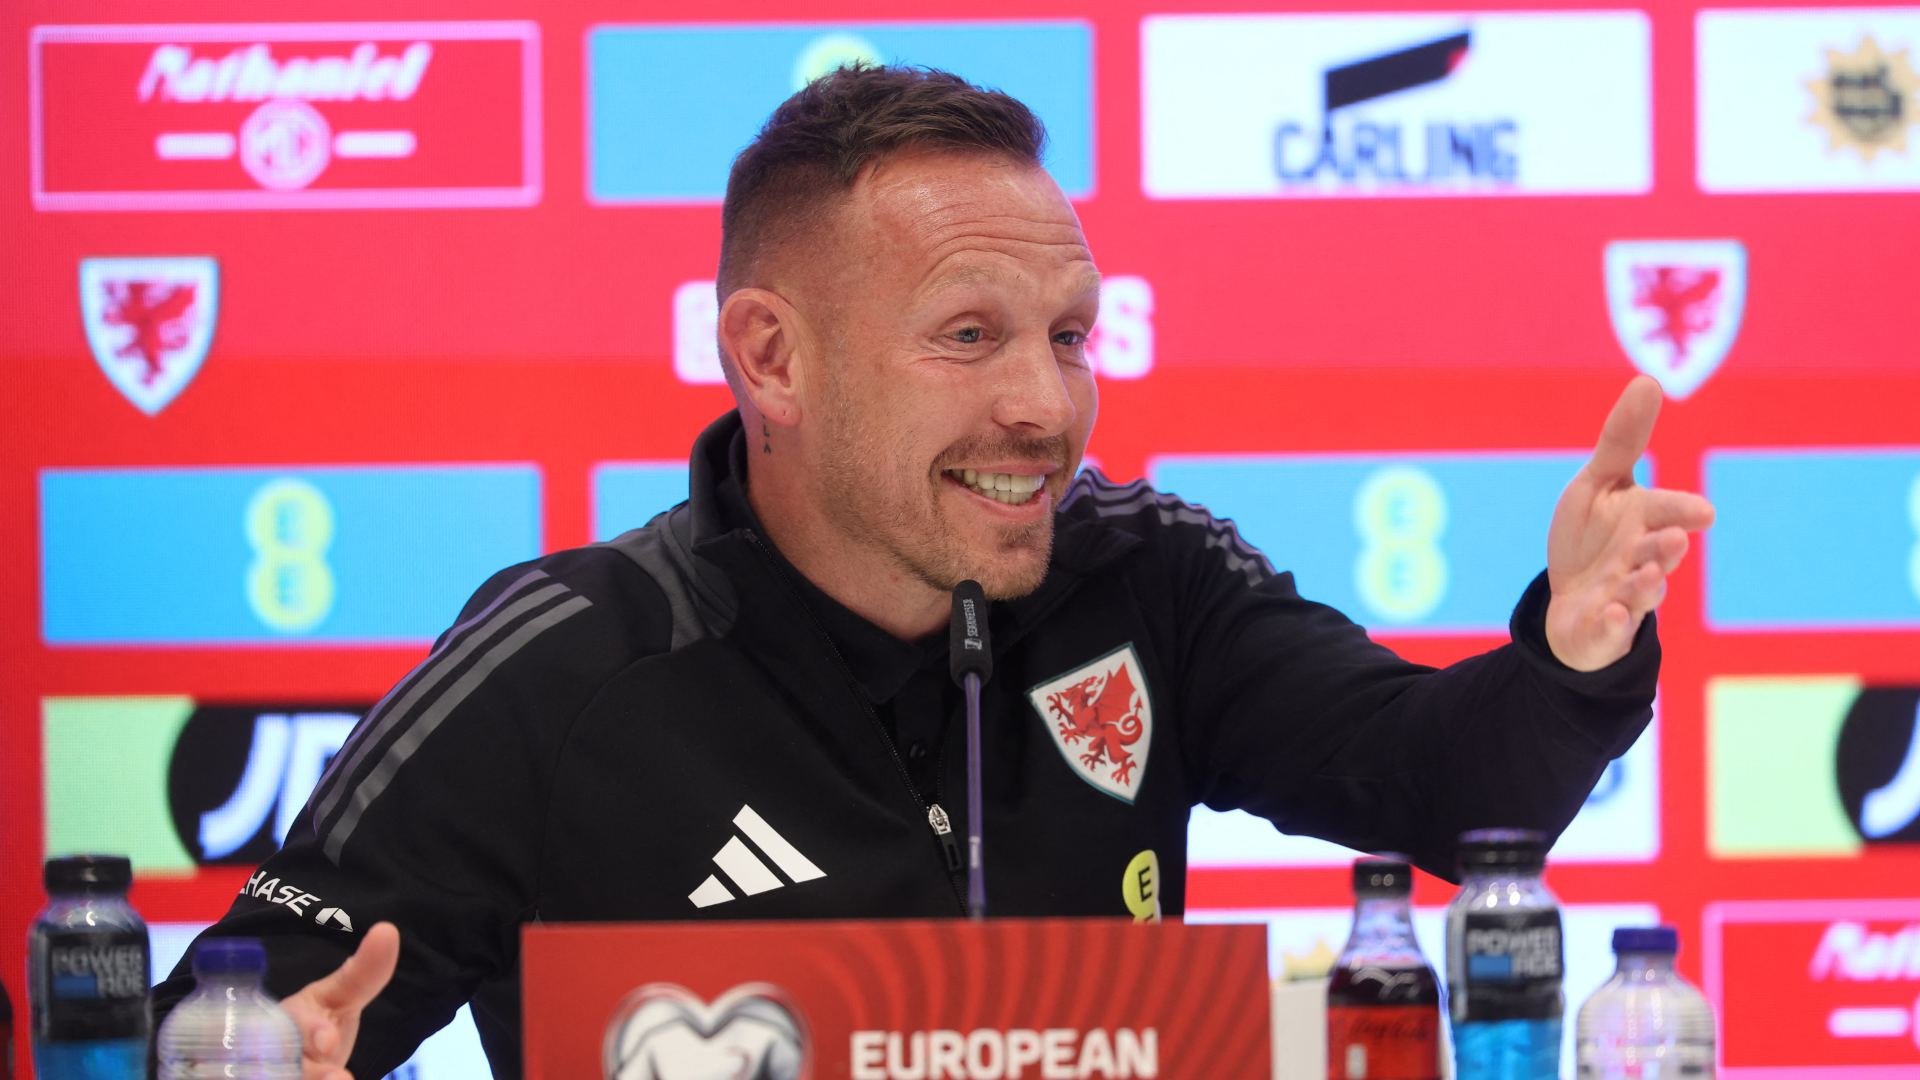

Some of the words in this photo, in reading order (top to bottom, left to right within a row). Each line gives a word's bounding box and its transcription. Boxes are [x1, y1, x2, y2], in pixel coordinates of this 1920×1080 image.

[1273, 120, 1519, 184] CARLING
[239, 870, 322, 917] HASE
[850, 1027, 1159, 1080] EUROPEAN
